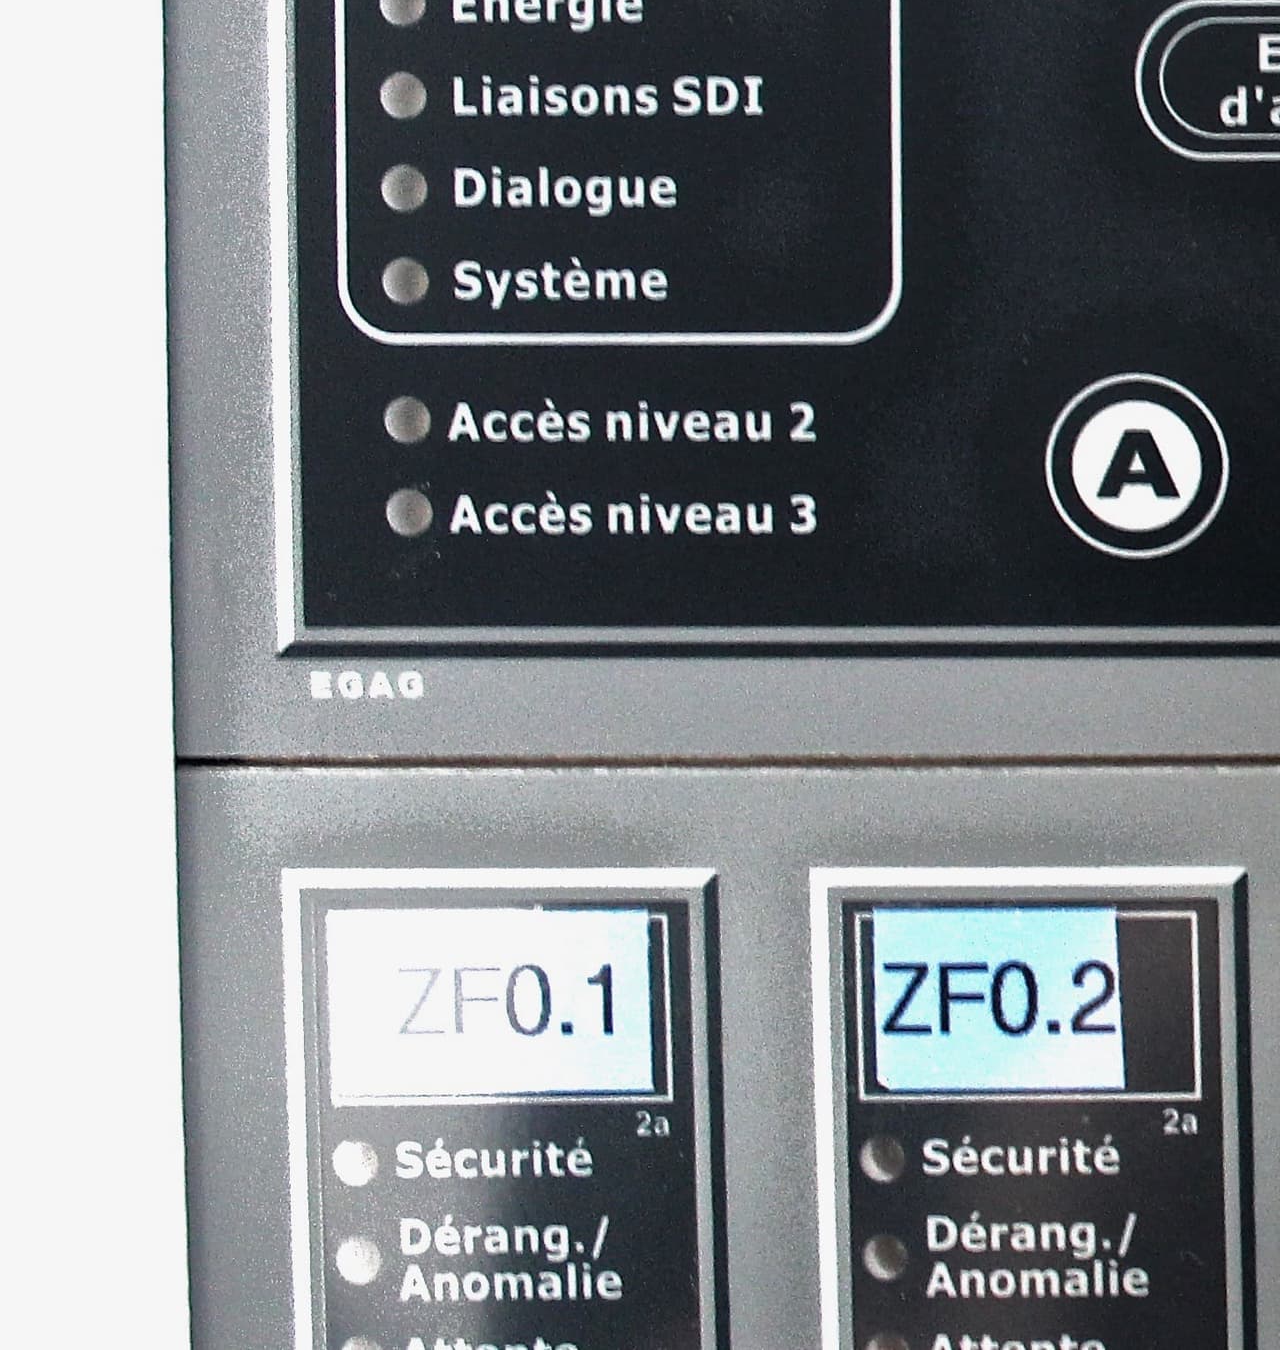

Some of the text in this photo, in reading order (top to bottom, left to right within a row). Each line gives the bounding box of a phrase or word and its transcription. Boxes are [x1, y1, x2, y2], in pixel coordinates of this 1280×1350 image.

[454, 76, 762, 115] Liaisons SDI
[455, 167, 676, 216] Dialogue
[454, 257, 667, 309] Système
[448, 399, 816, 441] Accès niveau 2
[1097, 430, 1180, 498] A
[451, 491, 816, 534] Accès niveau 3
[398, 964, 618, 1037] ZF0.1
[882, 959, 1117, 1036] ZF0.2
[637, 1111, 669, 1136] 2a
[1164, 1108, 1197, 1134] 2a
[391, 1137, 591, 1181] Sécurité
[923, 1136, 1119, 1174] Sécurité
[398, 1260, 621, 1303] Anomalie
[927, 1260, 1148, 1297] Anomalie
